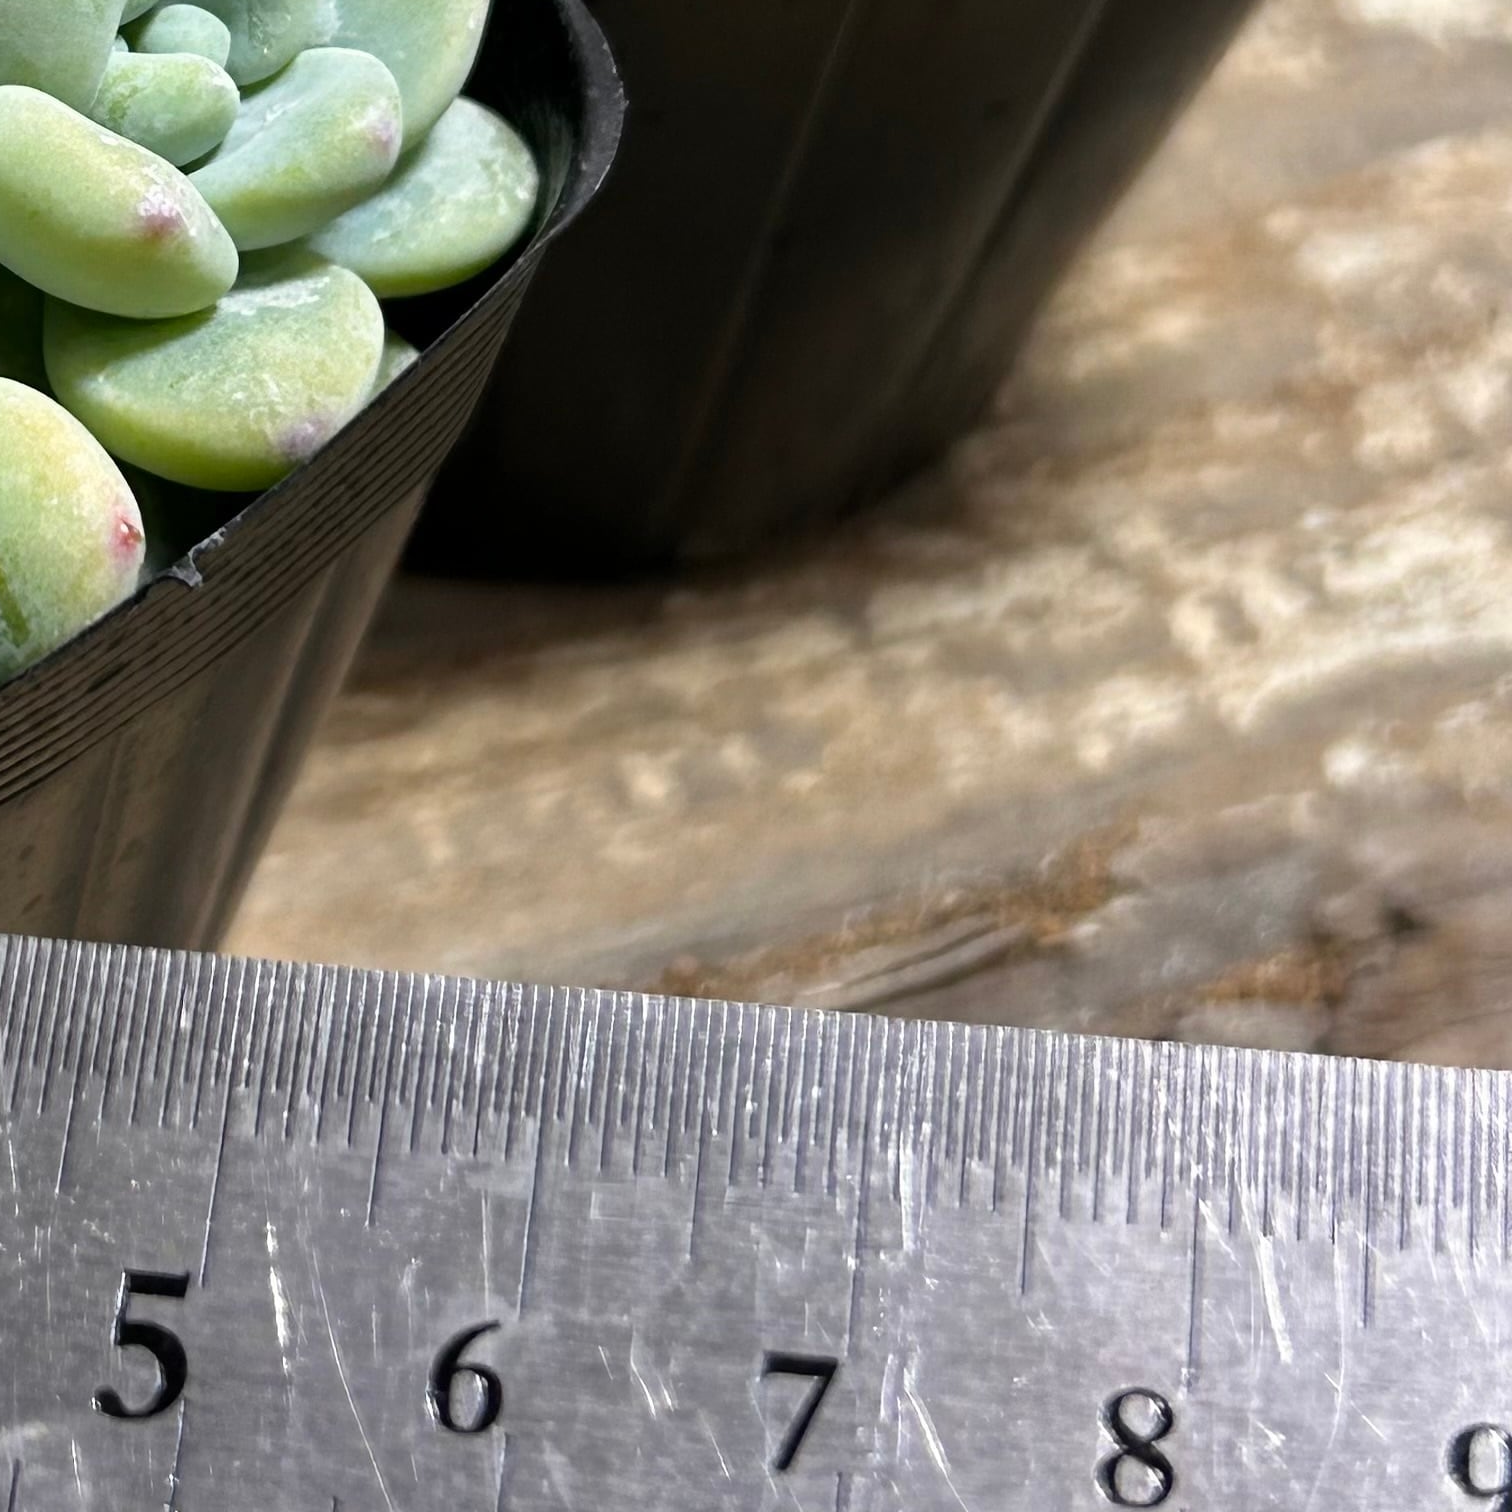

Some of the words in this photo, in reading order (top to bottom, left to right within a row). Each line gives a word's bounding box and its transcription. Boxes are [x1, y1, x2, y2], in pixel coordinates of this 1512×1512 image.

[91, 1268, 191, 1419] 5
[427, 1318, 504, 1434] 6
[760, 1349, 839, 1471] 7
[1096, 1385, 1176, 1508] 8
